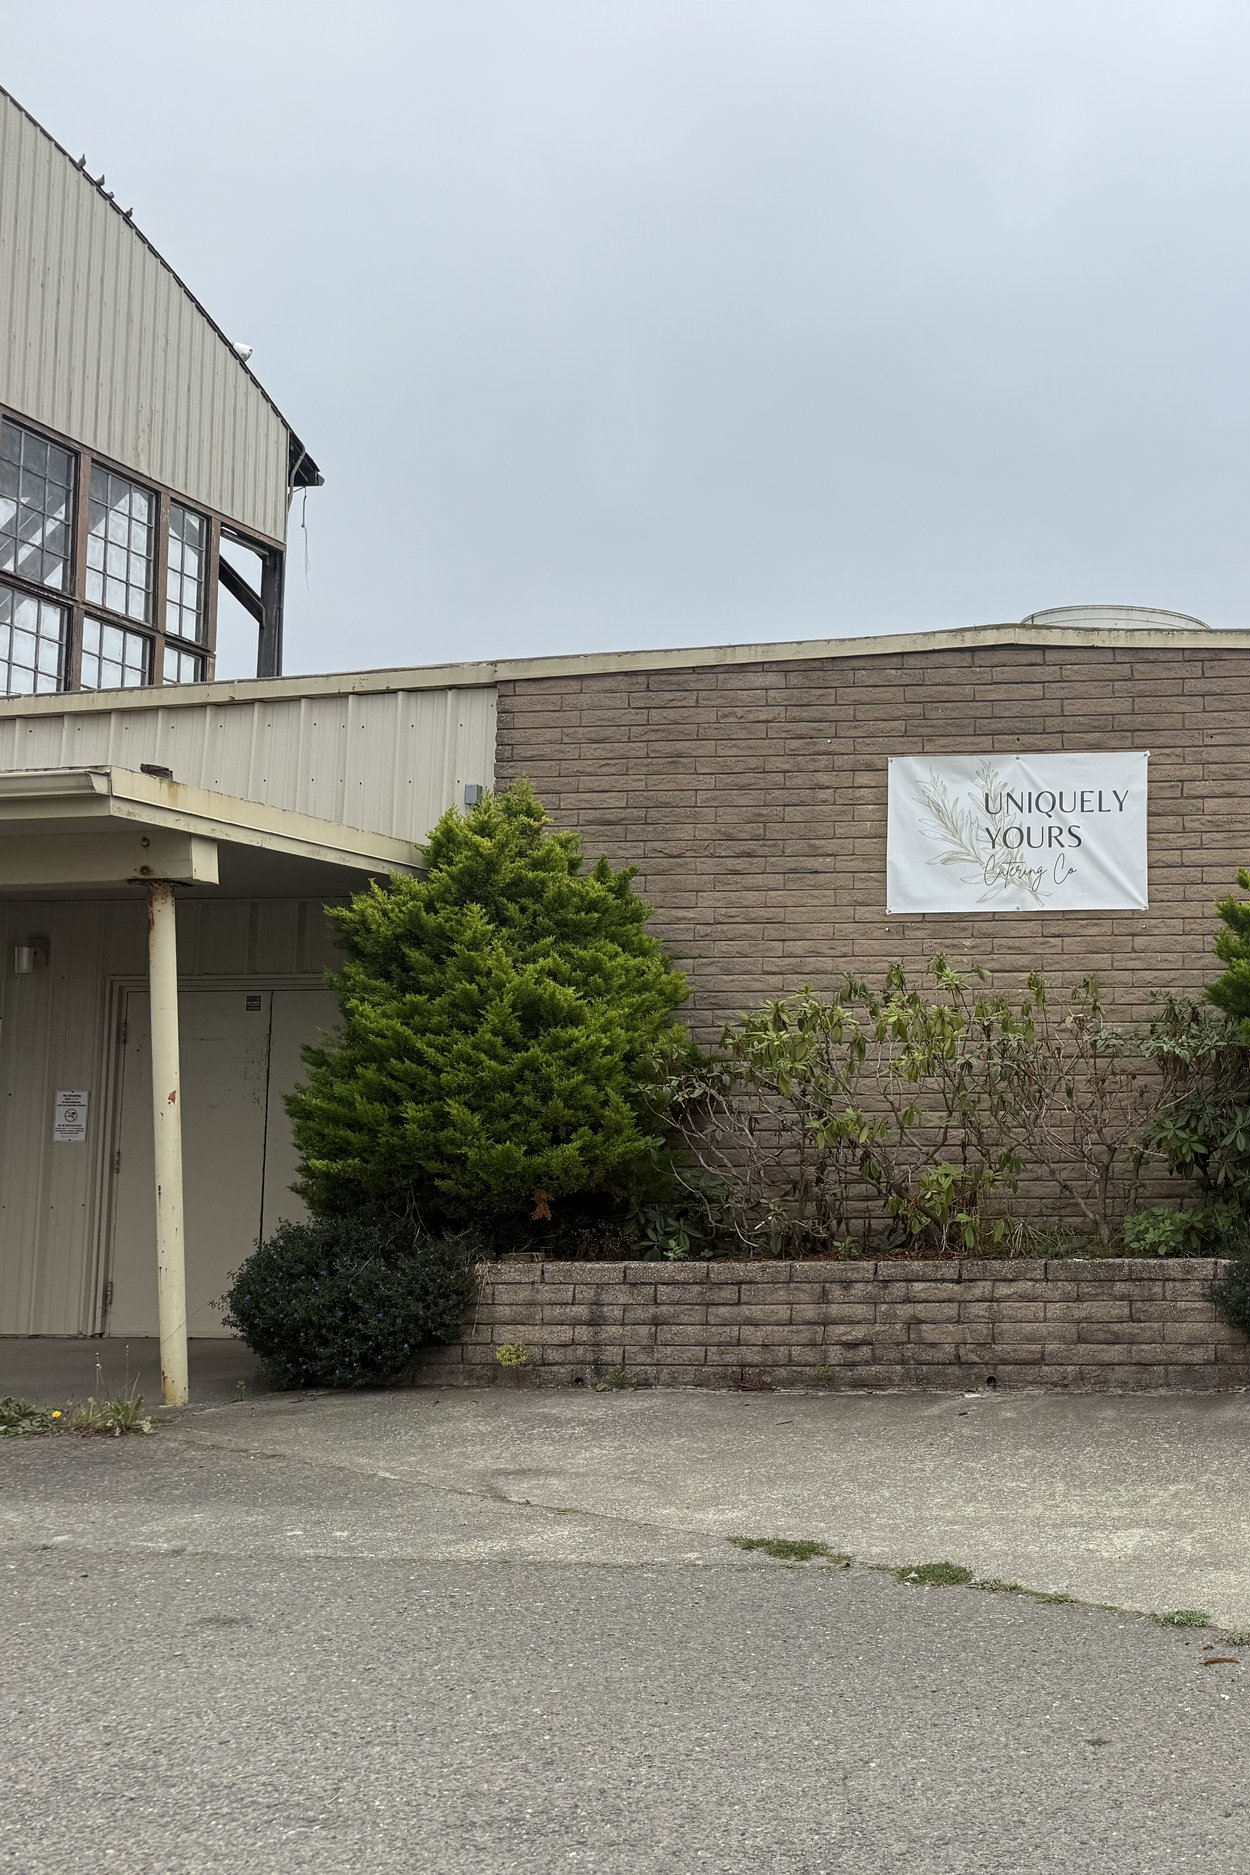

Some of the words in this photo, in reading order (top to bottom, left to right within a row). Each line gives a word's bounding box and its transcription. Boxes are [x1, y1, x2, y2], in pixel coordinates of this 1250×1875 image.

[985, 790, 1129, 818] UNIQUELY
[984, 824, 1083, 850] YOURS
[983, 854, 1048, 893] Catering
[1053, 852, 1078, 885] Co
